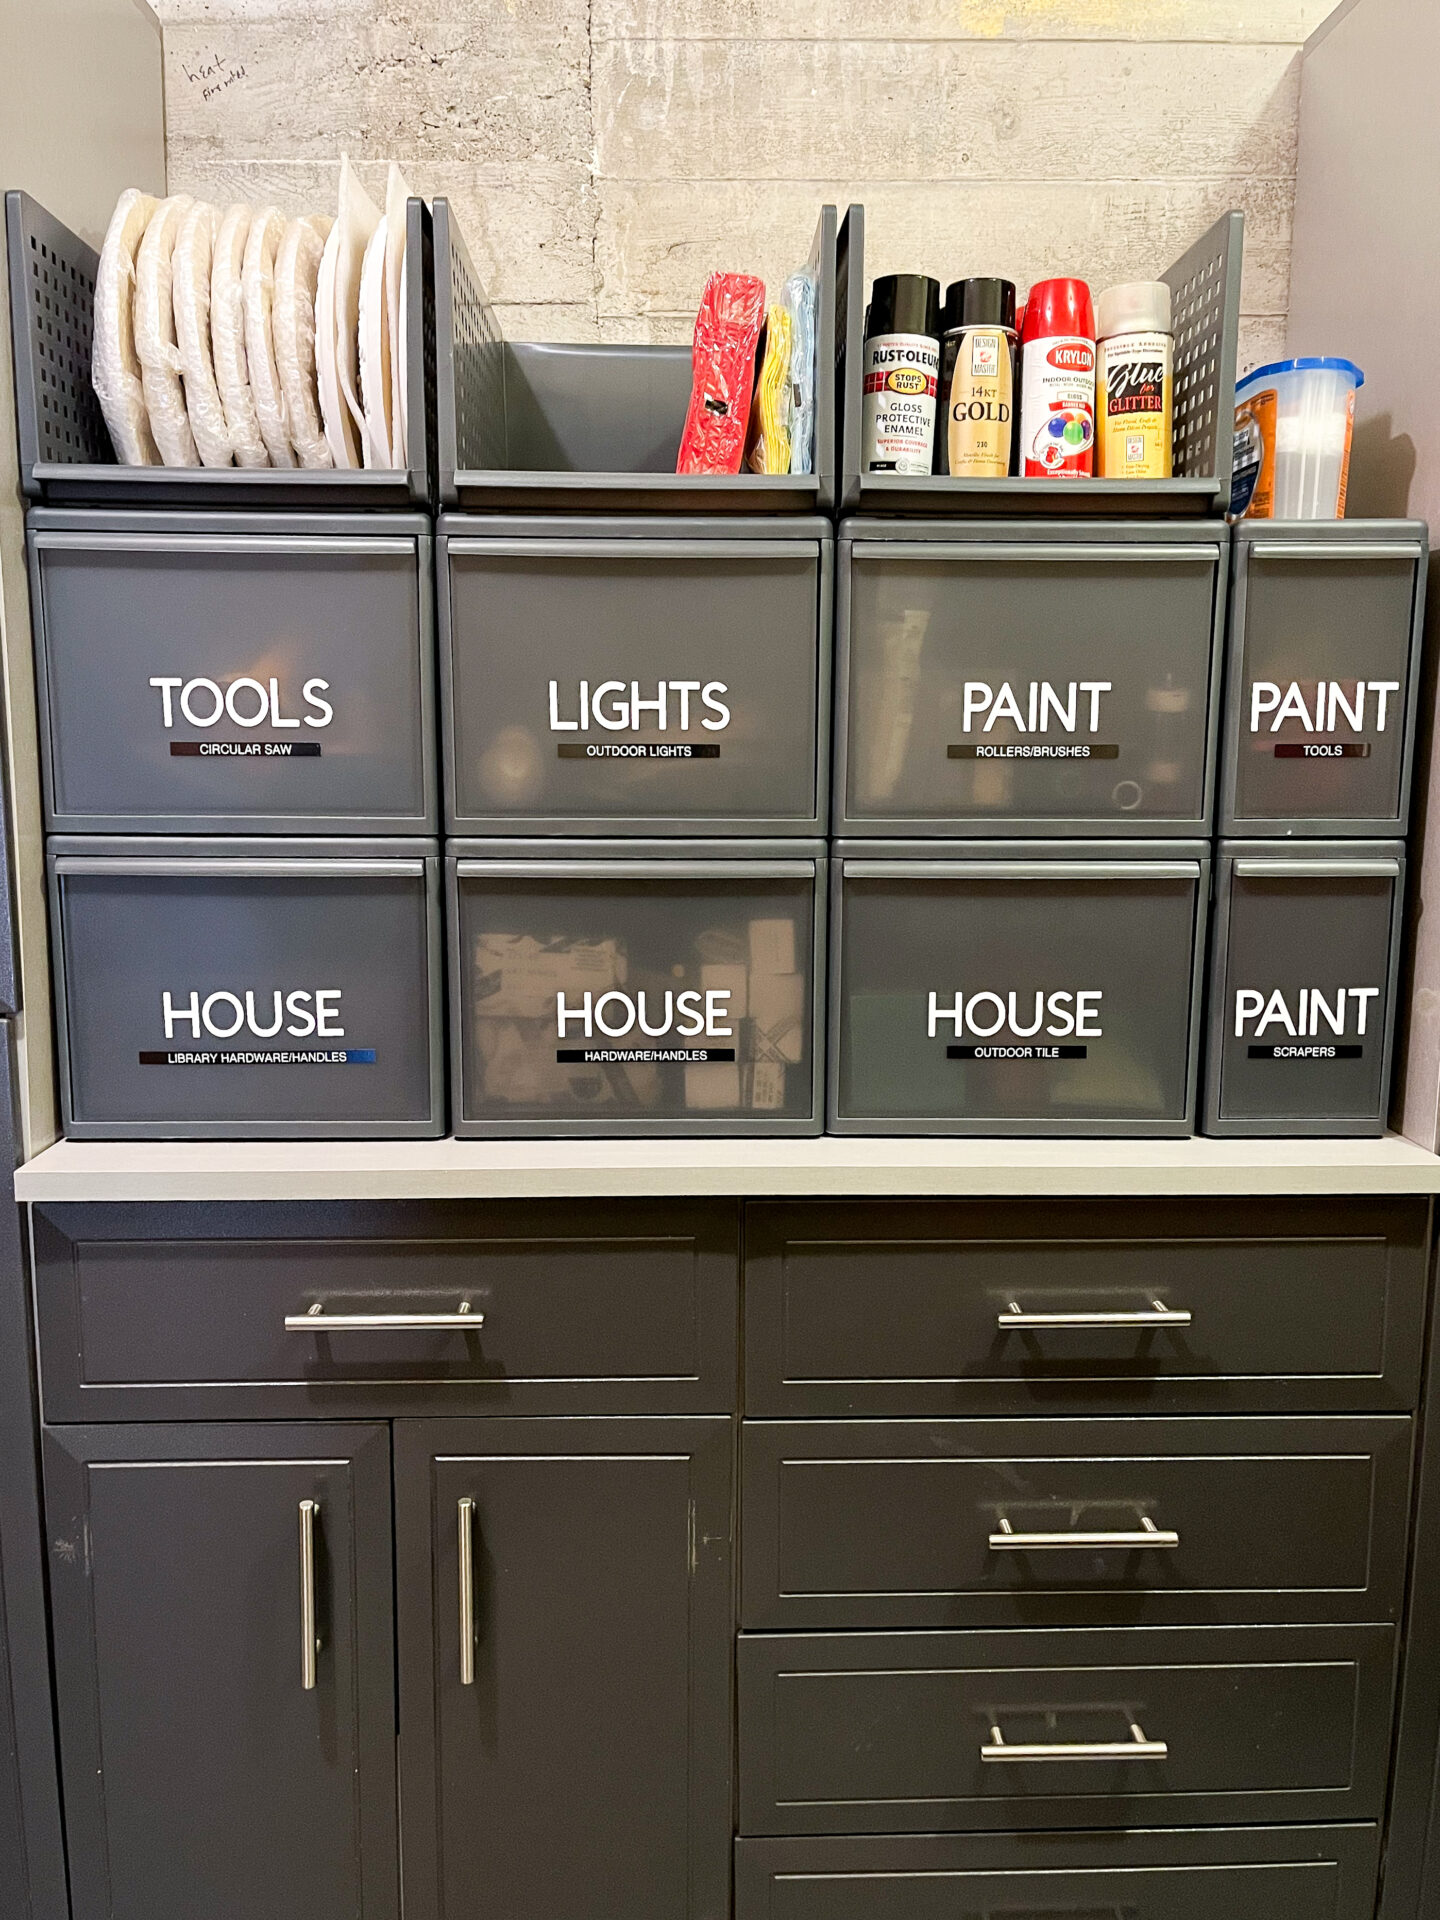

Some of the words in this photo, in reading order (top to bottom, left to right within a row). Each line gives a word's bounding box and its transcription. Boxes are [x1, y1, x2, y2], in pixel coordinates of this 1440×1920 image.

[975, 338, 996, 348] DESIGN
[1055, 350, 1092, 367] KRYLON
[895, 373, 922, 383] STOPS
[1106, 362, 1164, 398] Glue
[896, 381, 920, 390] RUST
[1139, 383, 1155, 395] for
[890, 402, 923, 413] GLOSS
[1109, 395, 1162, 413] GLITTER
[952, 401, 1010, 423] GOLD
[875, 413, 931, 428] PROTECTIVE
[884, 424, 924, 436] ENAMEL
[149, 677, 334, 728] TOOLS
[549, 680, 731, 731] LIGHTS
[962, 681, 1112, 733] PAINT
[1250, 681, 1400, 732] PAINT
[199, 743, 262, 756] CIRCULAR
[264, 743, 292, 756] SAW
[586, 745, 647, 757] OUTDOOR
[649, 745, 692, 757] LIGHTS
[976, 745, 1091, 757] ROLLERS/BRUSHES
[1303, 745, 1343, 757] TOOLS
[162, 989, 345, 1039] HOUSE
[556, 990, 733, 1038] HOUSE
[927, 990, 1103, 1038] HOUSE
[1234, 987, 1379, 1037] PAINT
[168, 1052, 218, 1064] LIBRARY
[220, 1051, 347, 1064] HARDWARE/HANDLES
[584, 1050, 708, 1062] HARDWARE/HANDLES
[974, 1047, 1033, 1058] OUTDOOR
[1034, 1047, 1060, 1058] TILE
[1273, 1046, 1336, 1057] SCRAPERS
